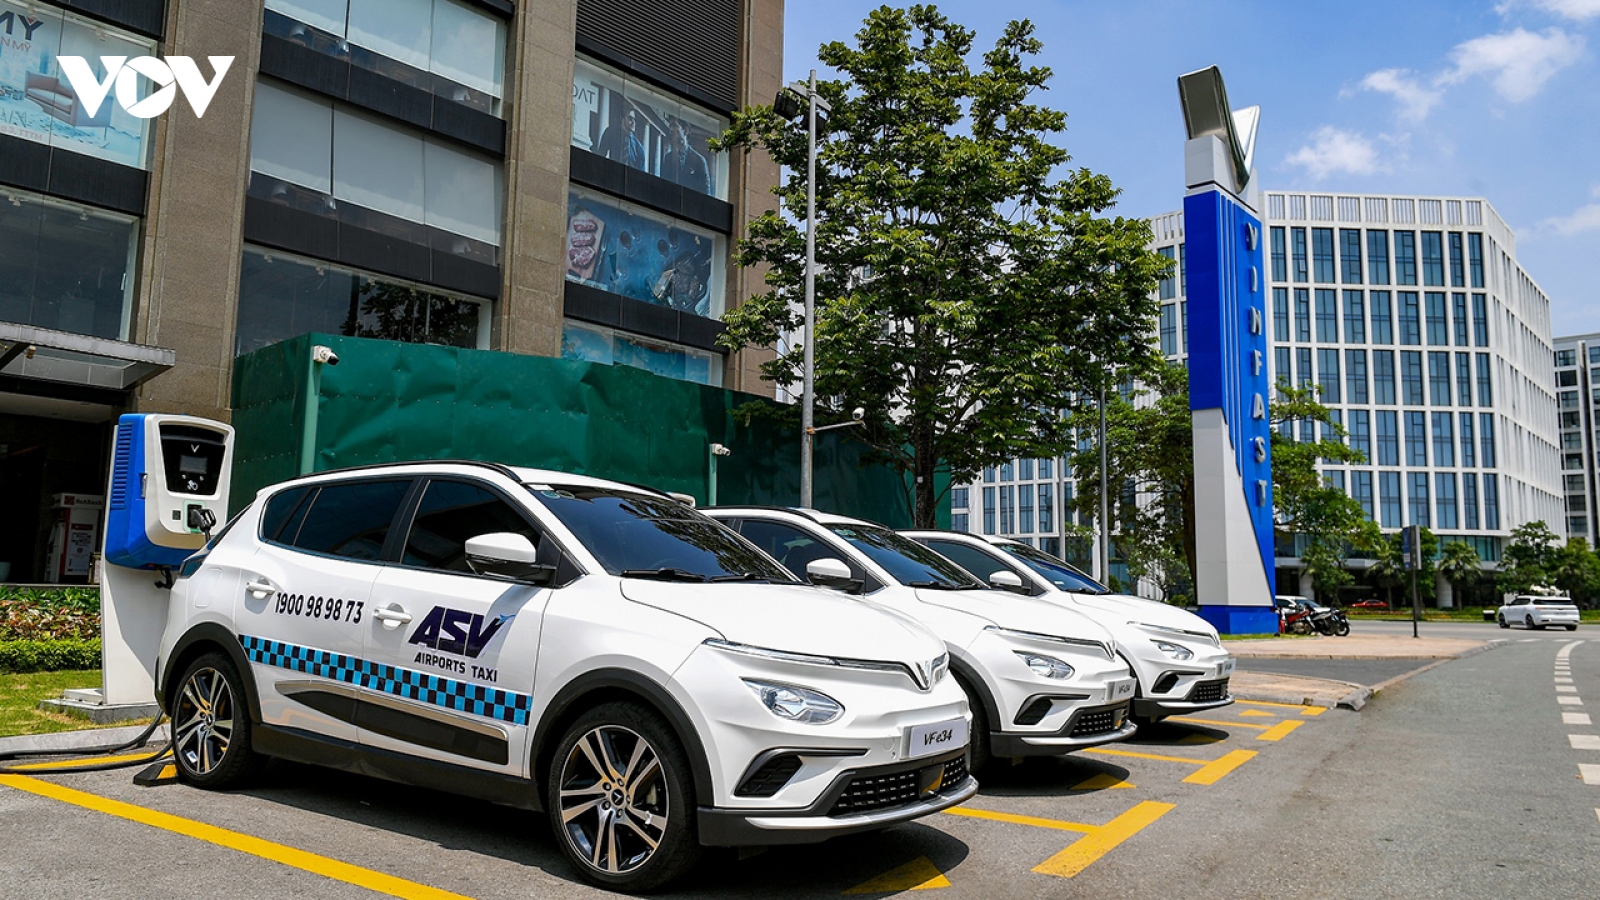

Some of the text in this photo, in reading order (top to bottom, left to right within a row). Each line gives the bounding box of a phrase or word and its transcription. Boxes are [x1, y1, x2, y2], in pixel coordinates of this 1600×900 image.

[1246, 222, 1267, 507] VINFAST
[275, 592, 364, 624] 1900 98 98 73
[408, 605, 508, 659] ASV
[414, 652, 498, 682] AIRPORTS TAXI
